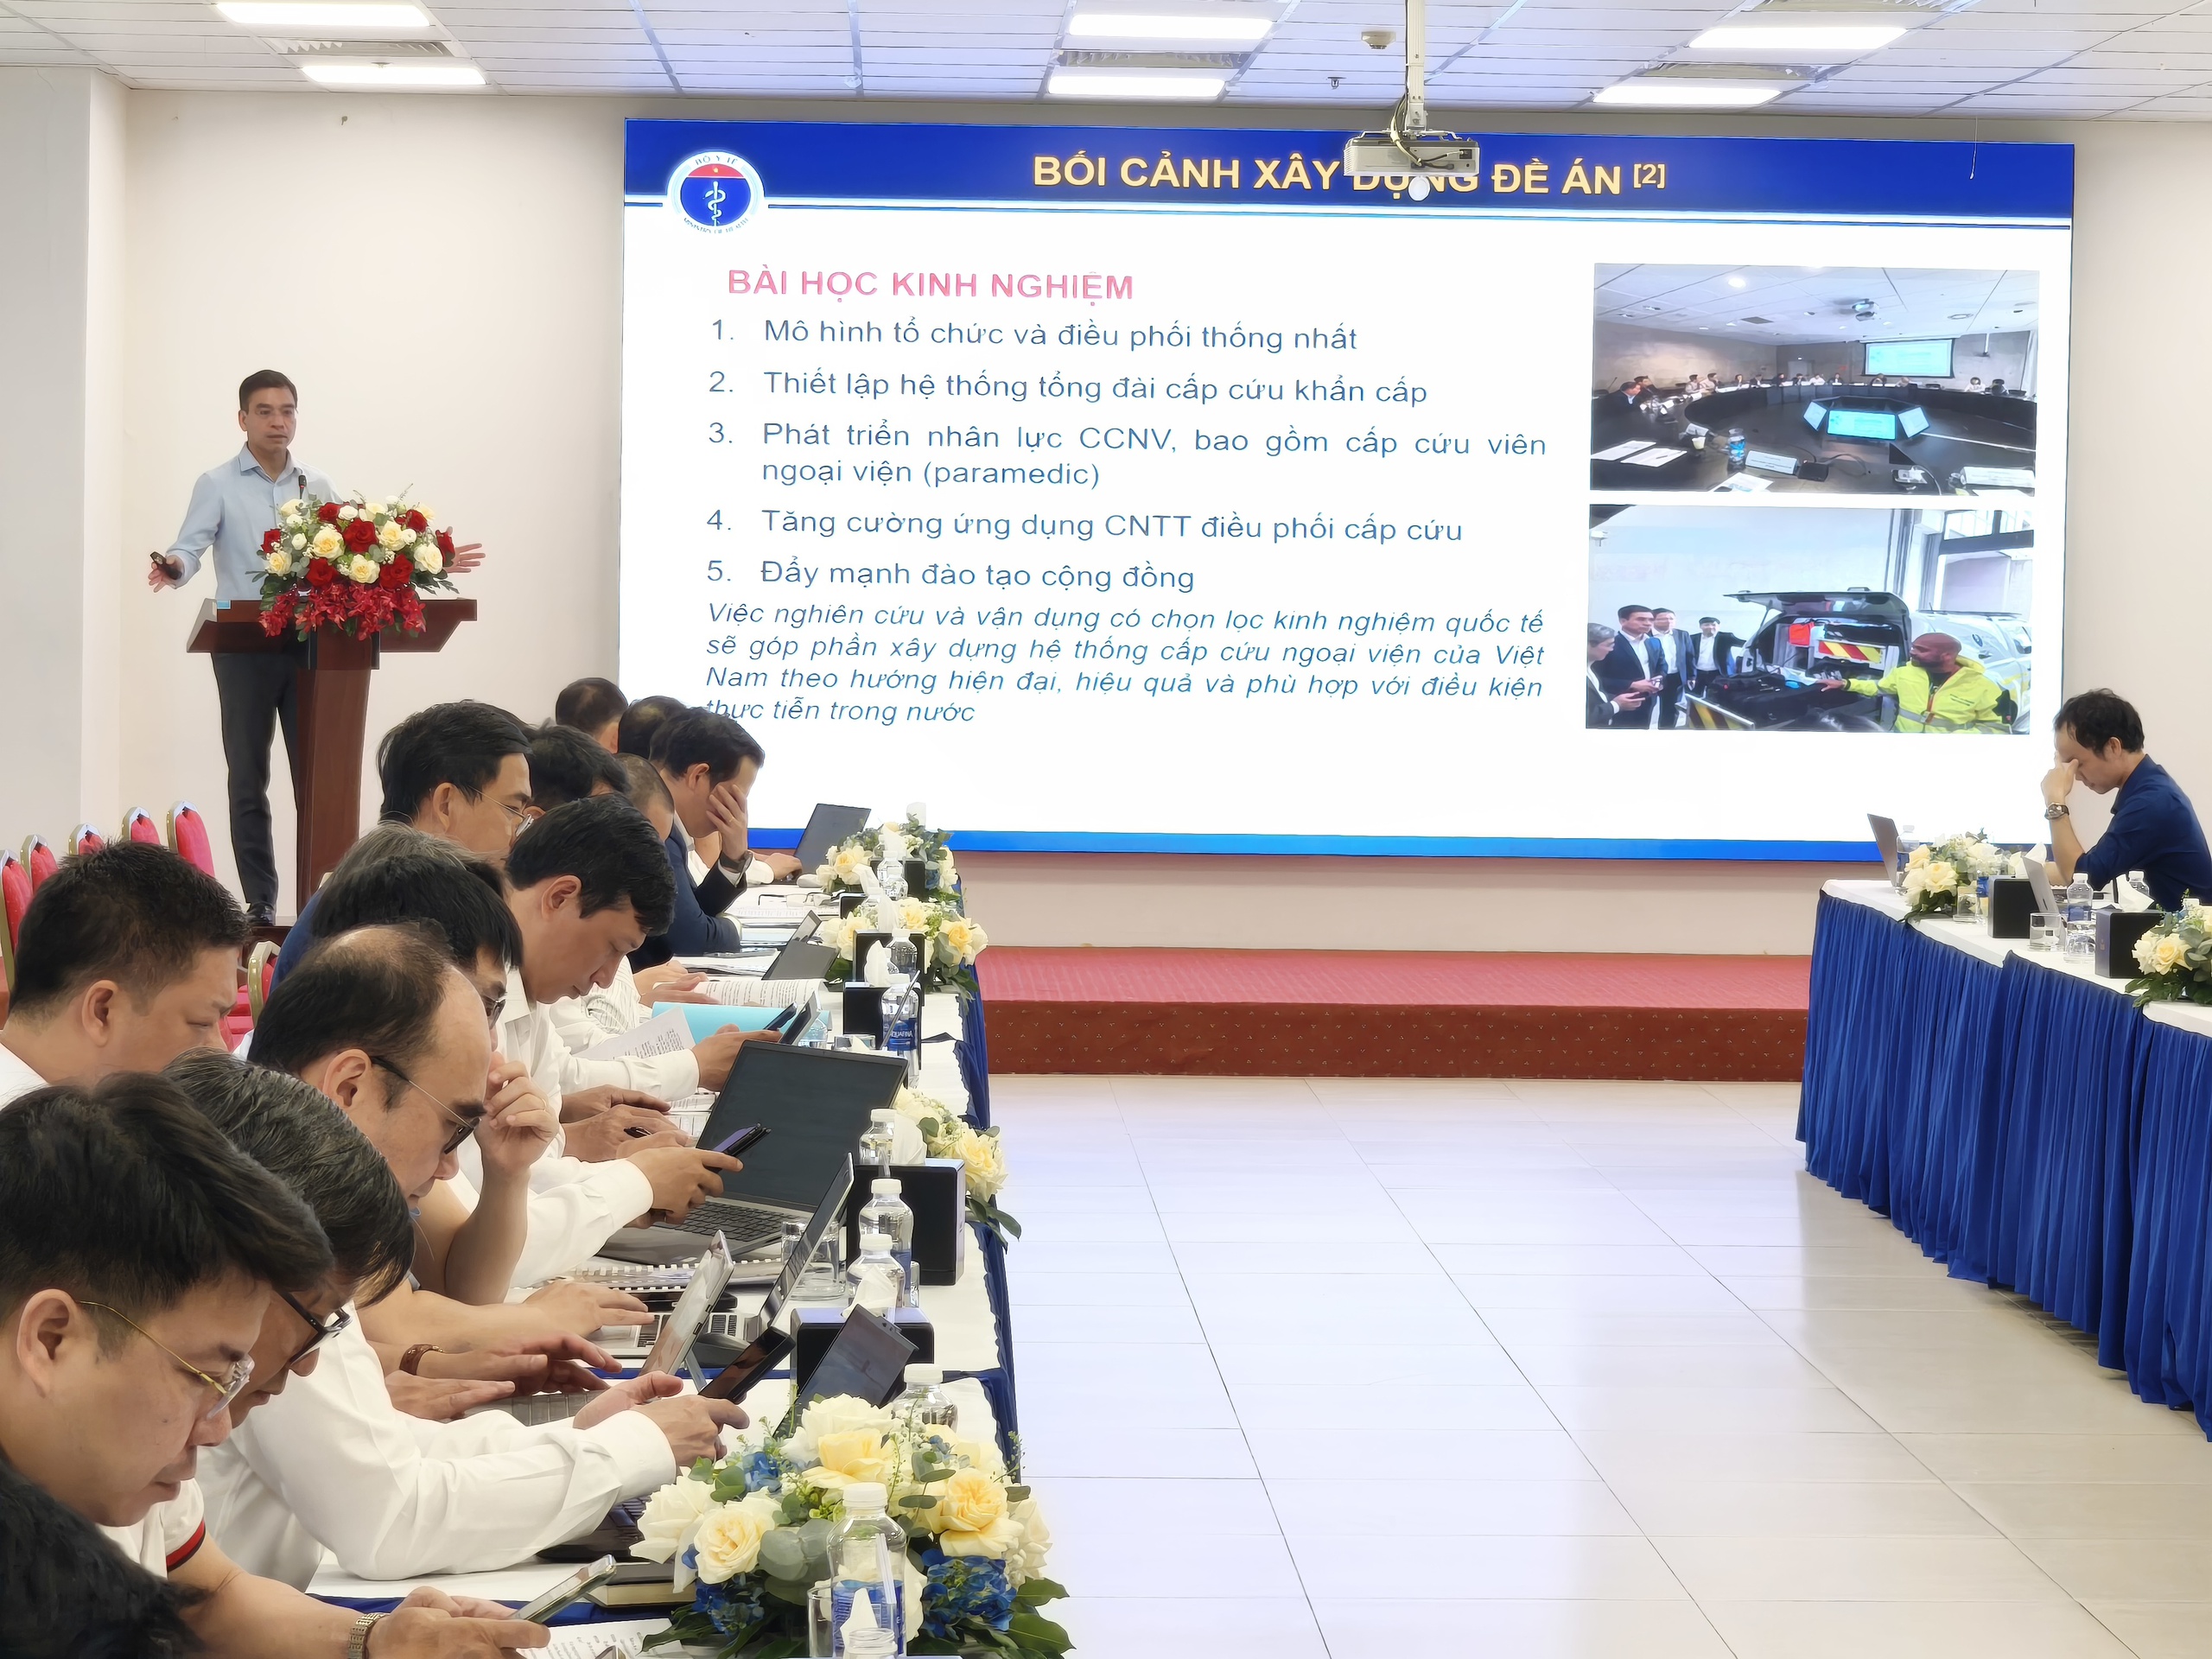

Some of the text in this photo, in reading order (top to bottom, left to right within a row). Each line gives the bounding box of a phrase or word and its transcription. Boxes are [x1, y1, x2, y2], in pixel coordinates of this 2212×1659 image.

[1033, 149, 1106, 188] BỐI
[1120, 150, 1241, 189] CẢNH
[1253, 152, 1341, 190] XÂY
[1491, 157, 1549, 194] ĐỀ
[1560, 157, 1621, 195] ÁN
[1633, 162, 1666, 189] [2]
[729, 264, 1132, 306] BÀI HỌC KINH NGHIỆM
[713, 316, 1357, 353] 1. Mô hình tổ chức và điều phối thống nhất
[709, 367, 1427, 408] 2. Thiết lập hệ thống tổng đài cấp cứu khẩn cấp
[709, 419, 1545, 458] 3. Phát triển nhân lực CCNV, bao gồm cấp cứu viên
[764, 460, 1098, 490] ngoại viện (paramedic)
[707, 510, 1461, 544] 4. Tăng cường ứng dụng CNTT điều phối cấp cứu
[708, 556, 1193, 593] 5. Đẩy mạnh đào tạo cộng đồng
[709, 603, 1543, 637] Việc nghiên cứu và vận dụng có chọn lọc kinh nghiệm quốc tế
[707, 632, 1544, 668] sẽ góp phần xây dựng hệ thống cấp cứu ngoại viện của Việt
[707, 667, 1541, 700] Nam theo hướng hiện đại, hiệu quả và phù hợp với điều kiện
[774, 696, 819, 719] tiễn
[831, 702, 897, 726] trong
[907, 702, 975, 721] nước
